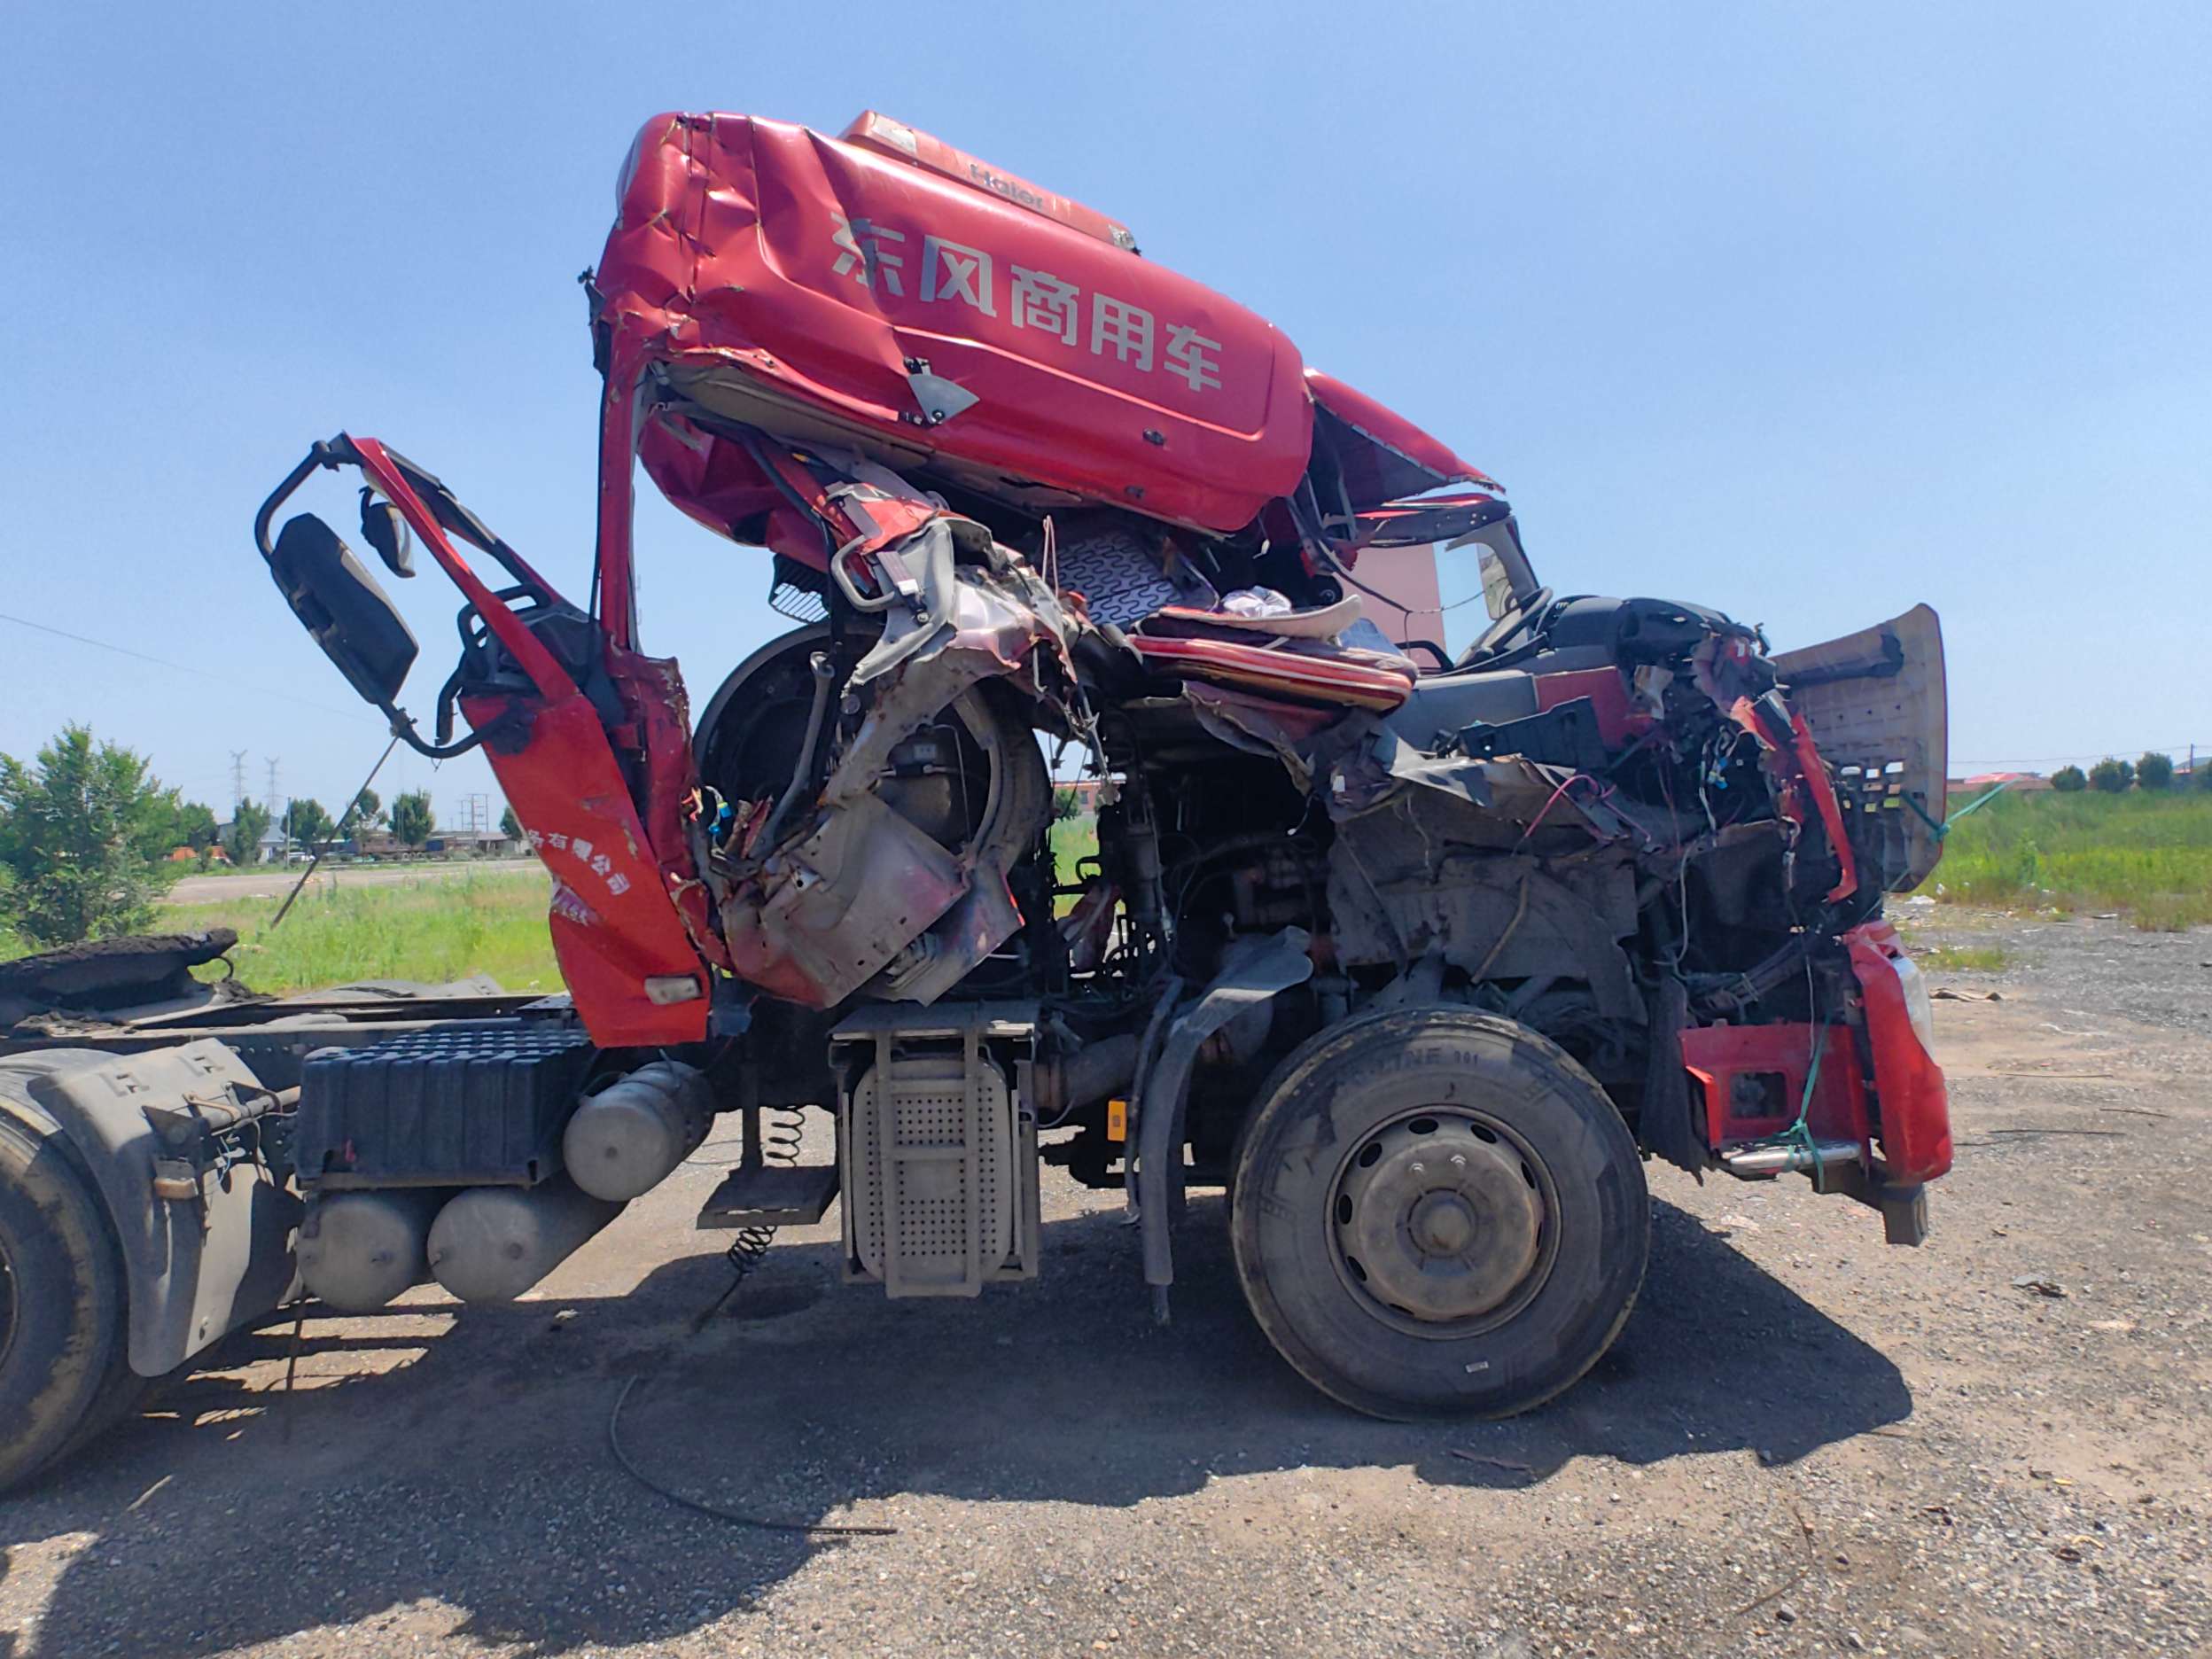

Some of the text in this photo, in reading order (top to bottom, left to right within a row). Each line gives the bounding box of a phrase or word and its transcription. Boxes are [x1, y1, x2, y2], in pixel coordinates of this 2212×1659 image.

[970, 164, 1042, 209] Haier
[830, 212, 1222, 392] 东风商用车
